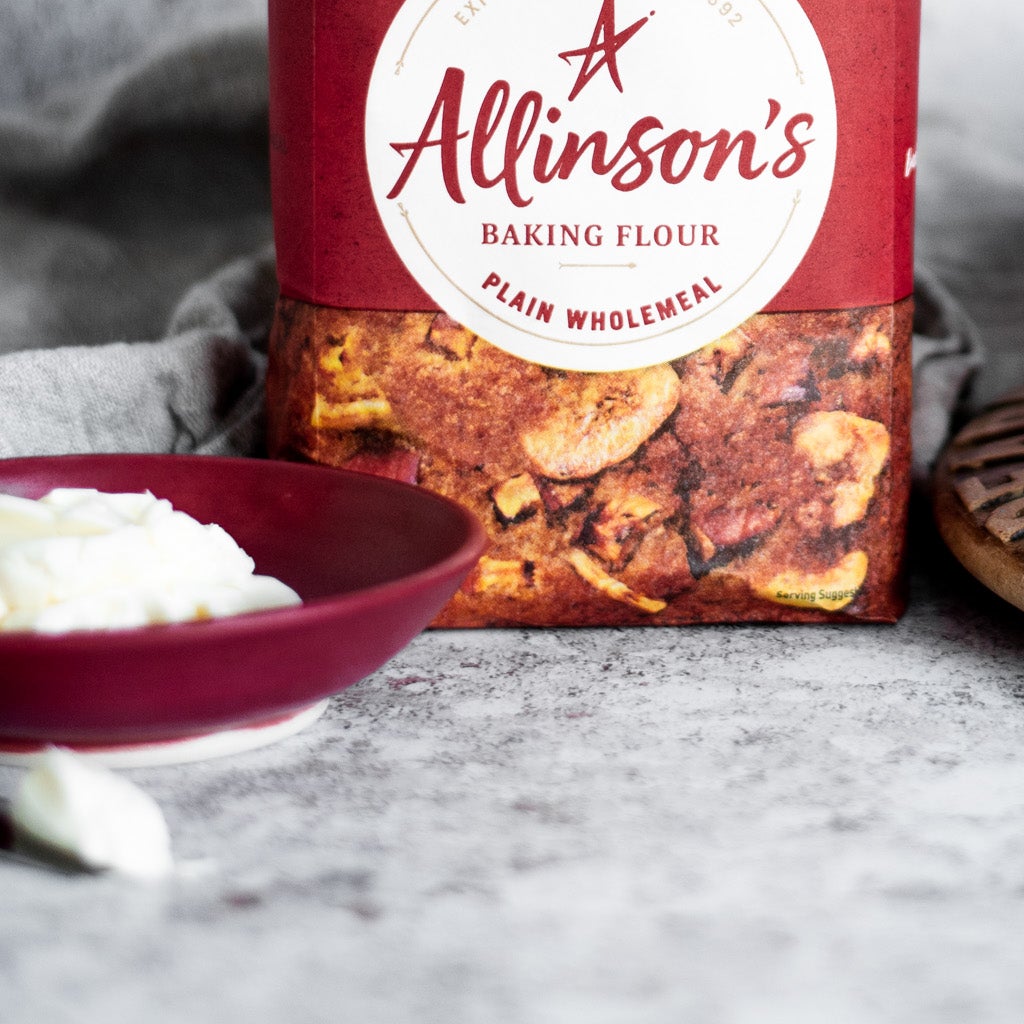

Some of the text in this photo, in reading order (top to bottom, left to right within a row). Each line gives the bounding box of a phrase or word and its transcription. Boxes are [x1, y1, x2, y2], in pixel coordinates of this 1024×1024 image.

[386, 67, 816, 208] Allinson's
[481, 223, 721, 247] BAKING FLOUR
[482, 272, 723, 331] PLAIN WHOLEMEAL
